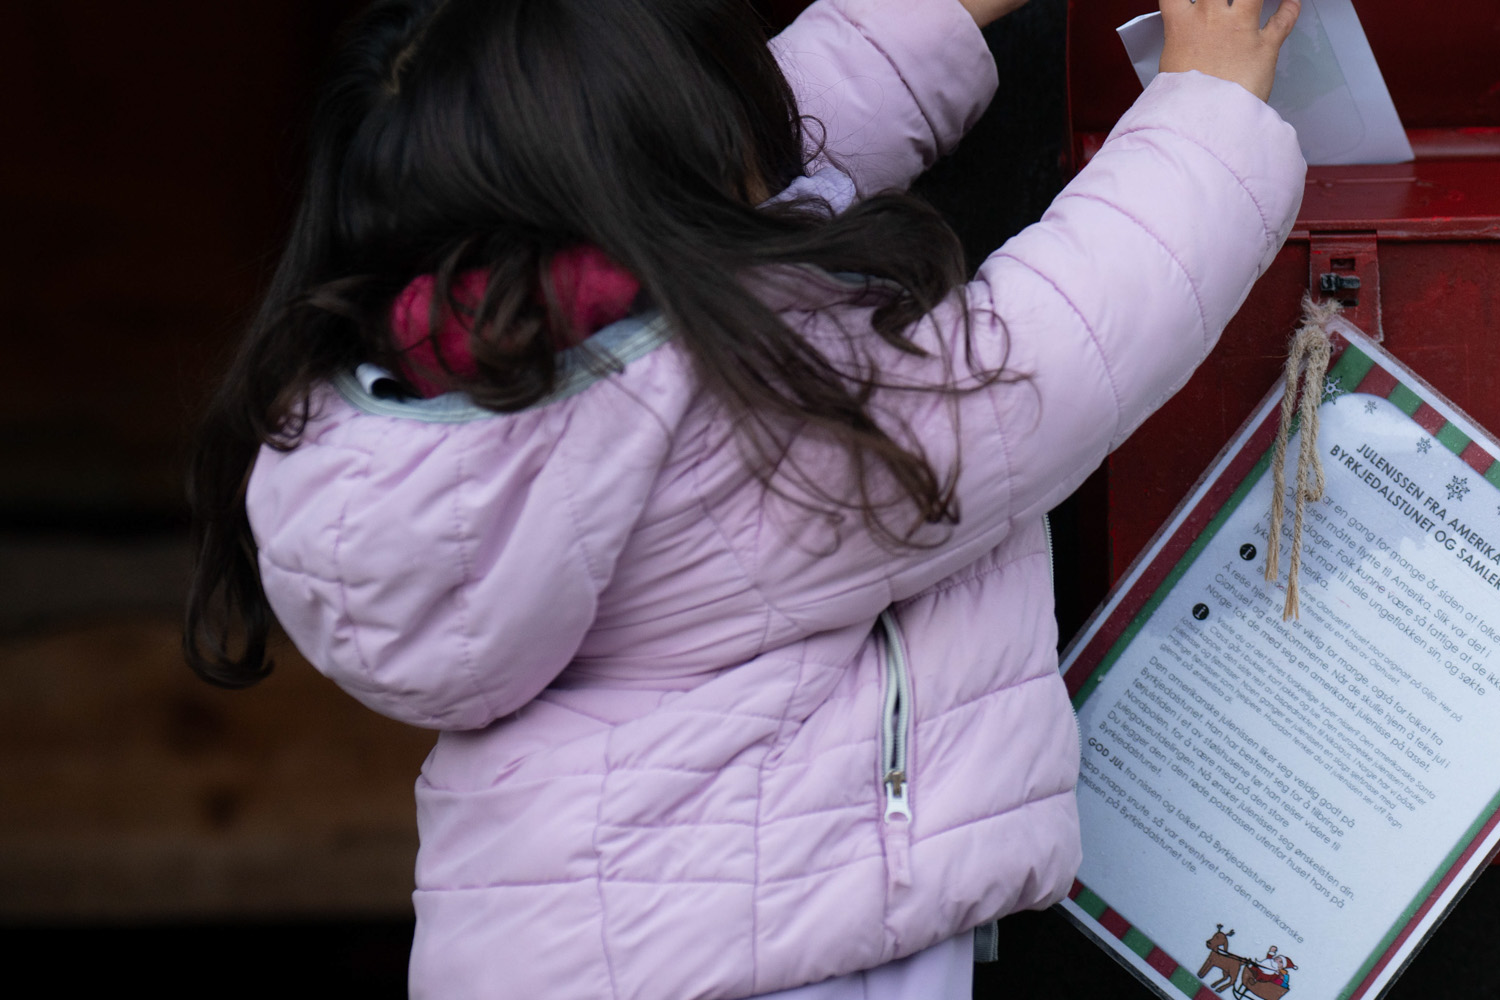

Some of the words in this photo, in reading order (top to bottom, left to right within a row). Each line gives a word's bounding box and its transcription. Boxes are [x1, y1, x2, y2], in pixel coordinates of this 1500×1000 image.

[1329, 444, 1435, 532] BYRKJEDALSTUNET
[1434, 529, 1457, 550] OG
[1332, 503, 1349, 519] en
[1345, 515, 1377, 543] gang
[1374, 535, 1392, 553] for
[1387, 549, 1426, 583] mange
[1425, 577, 1440, 592] år
[1435, 588, 1465, 614] siden
[1355, 443, 1424, 500] JULENISSEN
[1422, 496, 1446, 521] FRA
[1446, 517, 1500, 565] AMERIKA
[1313, 553, 1339, 575] mat
[1344, 576, 1369, 601] hele
[1367, 596, 1428, 649] ungeflokken
[1442, 659, 1460, 677] og
[1457, 671, 1486, 696] søkte
[1324, 520, 1357, 550] måtte
[1355, 543, 1382, 570] flytte
[1432, 607, 1451, 626] Slik
[1449, 622, 1469, 639] var
[1466, 636, 1487, 655] det
[1334, 547, 1357, 570] Folk
[1353, 563, 1386, 594] kunne
[1411, 613, 1428, 628] så
[1425, 622, 1460, 654] fattige
[1470, 661, 1487, 677] de
[1203, 582, 1233, 610] Norge
[1231, 604, 1248, 622] tok
[1258, 628, 1283, 650] med
[1279, 645, 1298, 665] seg
[1295, 659, 1310, 674] en
[1308, 670, 1358, 712] amerikansk
[1353, 706, 1392, 740] julenisse
[1388, 736, 1406, 752] på
[1213, 571, 1254, 608] Olahuset
[1250, 604, 1269, 620] og
[1329, 667, 1349, 686] Når
[1359, 693, 1385, 716] skulle
[1382, 710, 1407, 735] hjem
[1412, 735, 1435, 757] feire
[1429, 751, 1447, 767] jul
[1229, 568, 1252, 589] reise
[1249, 583, 1274, 608] hjem
[1302, 626, 1326, 650] viktig
[1323, 644, 1339, 660] for
[1369, 684, 1395, 705] også
[1391, 700, 1408, 715] for
[1404, 710, 1432, 736] folket
[1428, 730, 1444, 747] fra
[1147, 654, 1169, 676] Den
[1166, 671, 1221, 718] amerikanske
[1216, 712, 1260, 750] julenissen
[1257, 744, 1278, 764] liker
[1274, 760, 1294, 779] seg
[1292, 774, 1320, 801] veldig
[1317, 796, 1343, 818] godt
[1338, 814, 1356, 829] på
[1169, 725, 1185, 741] for
[1213, 763, 1239, 785] med
[1233, 781, 1251, 796] på
[1248, 792, 1269, 811] den
[1266, 806, 1290, 828] store
[1189, 726, 1204, 739] av
[1249, 773, 1265, 789] før
[1261, 783, 1282, 804] han
[1279, 799, 1305, 822] reiser
[1303, 818, 1332, 845] videre
[1203, 718, 1224, 739] Han
[1221, 732, 1240, 751] har
[1236, 745, 1275, 779] bestemt
[1271, 776, 1291, 795] seg
[1288, 788, 1304, 803] for
[1309, 805, 1345, 838] tilbringe
[1086, 736, 1110, 758] GOD
[1107, 754, 1125, 771] JUL
[1122, 765, 1138, 782] fra
[1135, 777, 1163, 803] nissen
[1160, 798, 1177, 814] og
[1173, 807, 1201, 832] folket
[1196, 829, 1214, 844] på
[1211, 838, 1276, 895] Byrkjedalstunet
[1097, 771, 1128, 798] snapp
[1150, 815, 1166, 829] så
[1163, 824, 1180, 840] var
[1176, 837, 1220, 874] eventyret
[1216, 870, 1234, 887] om
[1232, 883, 1253, 902] den
[1250, 898, 1305, 944] amerikanske
[1103, 794, 1121, 810] på
[1118, 804, 1183, 861] Byrkjedalstunet
[1105, 708, 1122, 725] Du
[1118, 719, 1150, 748] legger
[1147, 744, 1167, 763] den
[1169, 762, 1190, 781] den
[1186, 776, 1210, 798] røde
[1206, 794, 1256, 836] postkassen
[1254, 831, 1288, 861] utenfor
[1284, 855, 1312, 881] huset
[1308, 875, 1332, 898] hans
[1327, 894, 1346, 909] på
[1195, 765, 1212, 782] Nå
[1209, 778, 1240, 804] ønsker
[1235, 798, 1279, 837] julenissen
[1276, 833, 1295, 852] seg
[1292, 847, 1340, 888] ønskelisten
